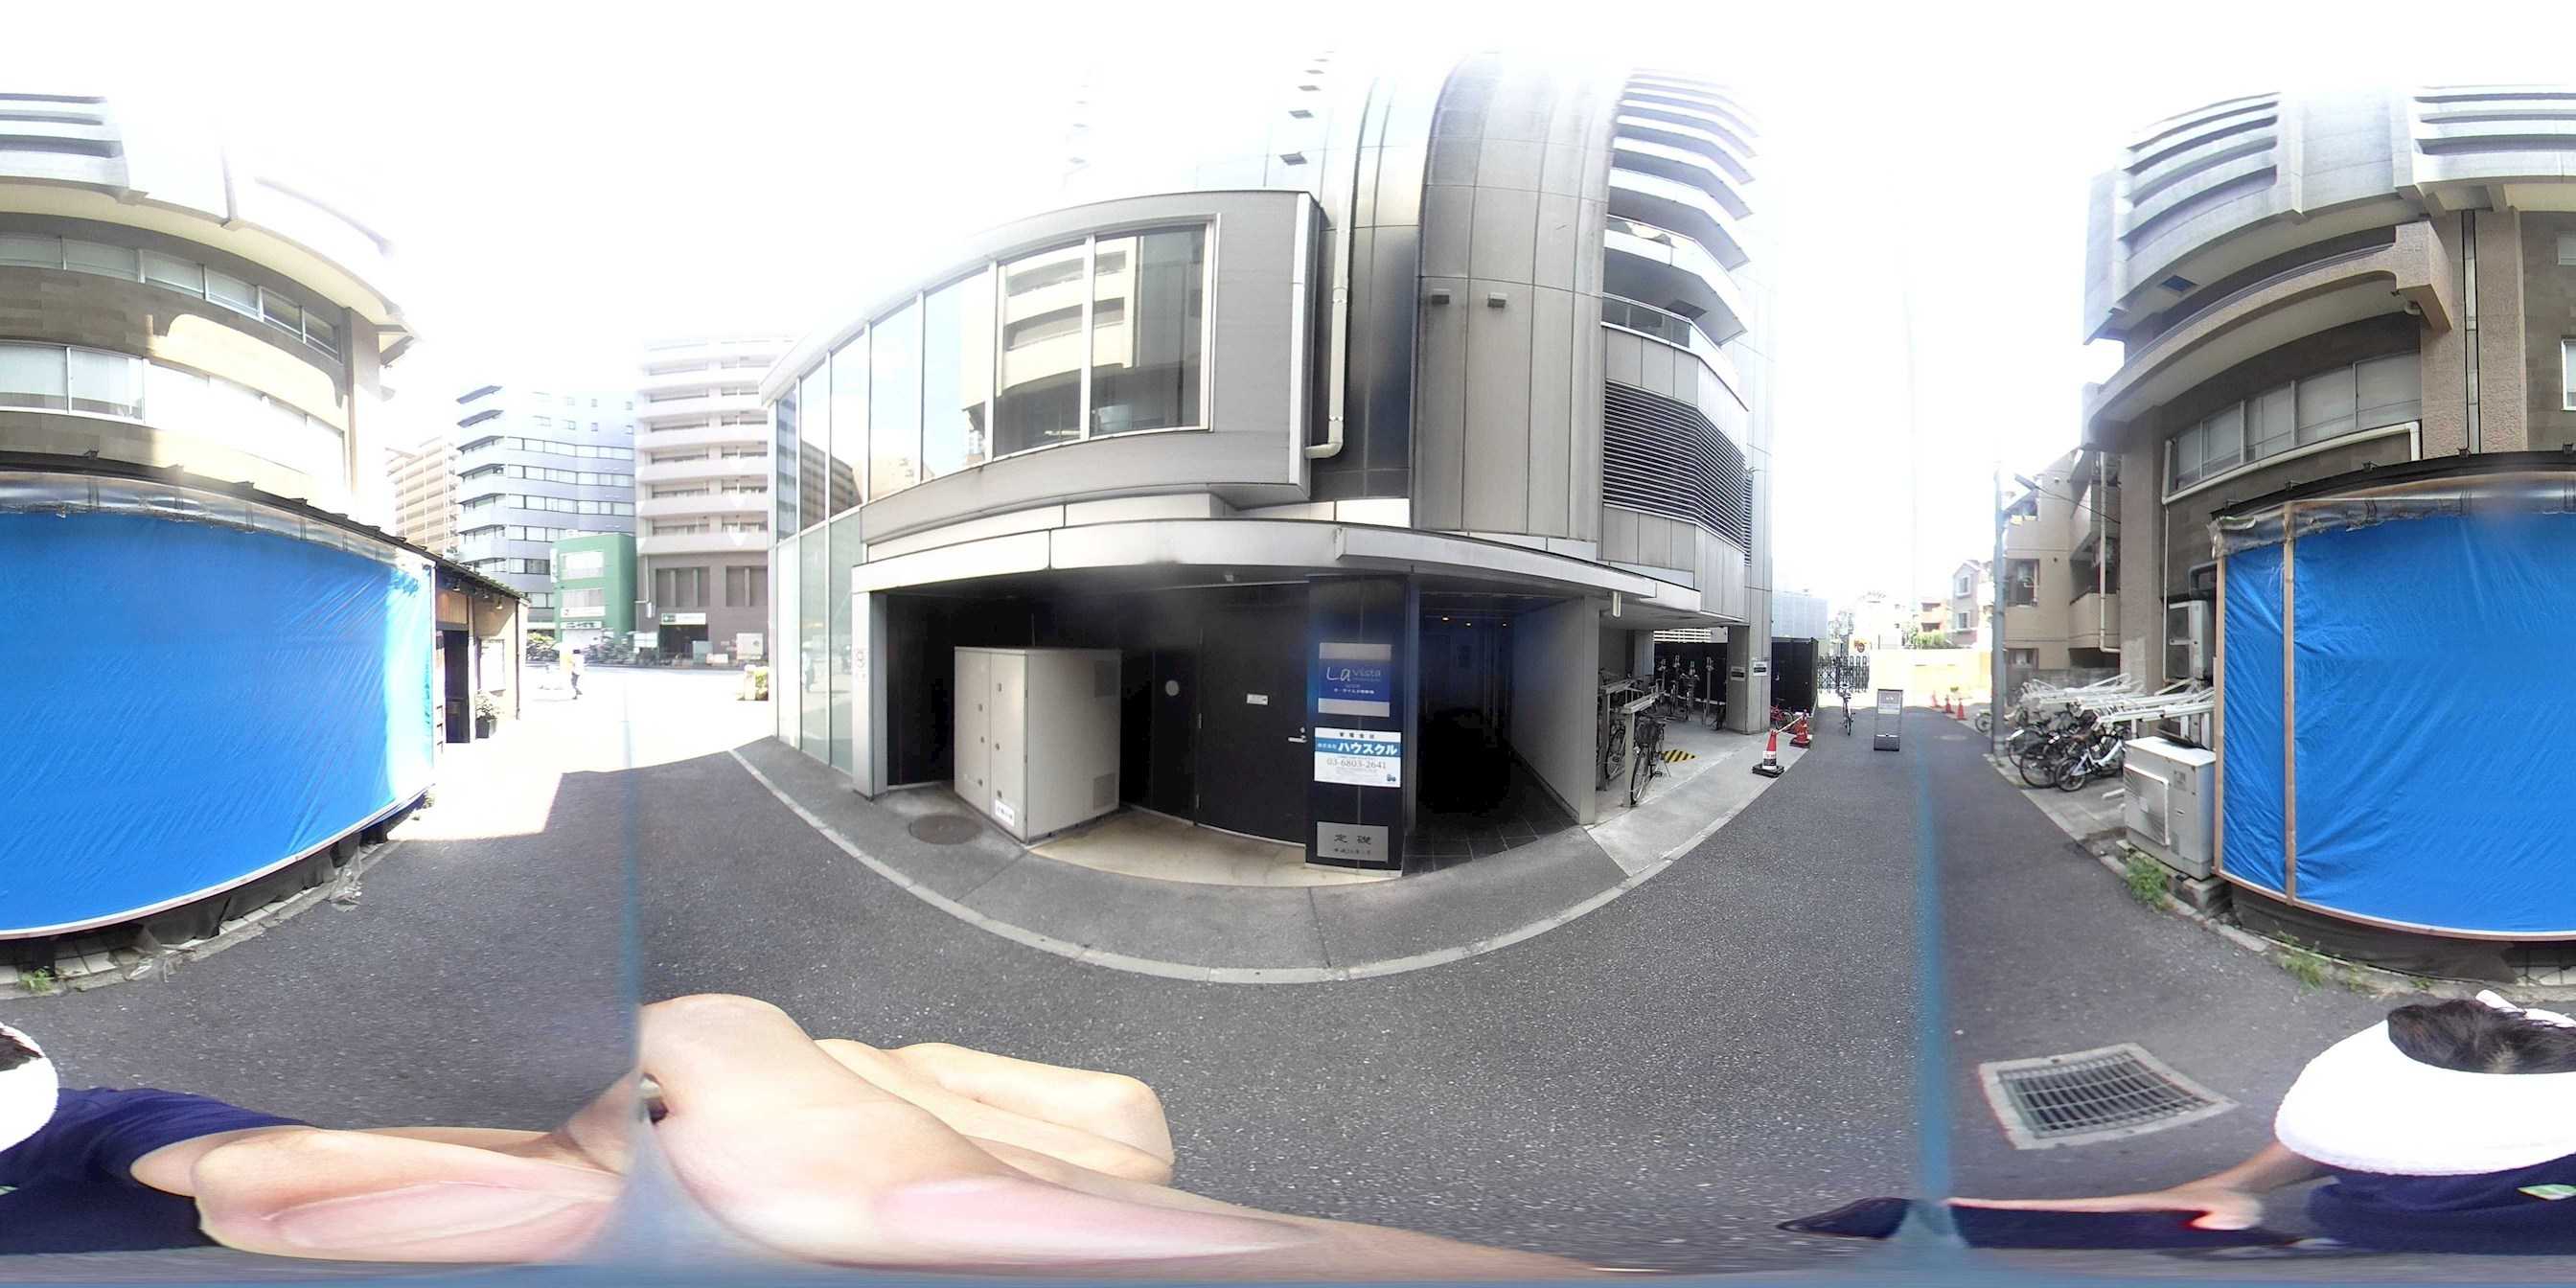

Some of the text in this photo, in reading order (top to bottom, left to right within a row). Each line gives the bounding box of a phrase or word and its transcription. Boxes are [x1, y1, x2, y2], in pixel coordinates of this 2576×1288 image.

[1326, 666, 1350, 681] La
[1338, 742, 1397, 755] ハウスクル
[1334, 834, 1371, 844] 定礎
